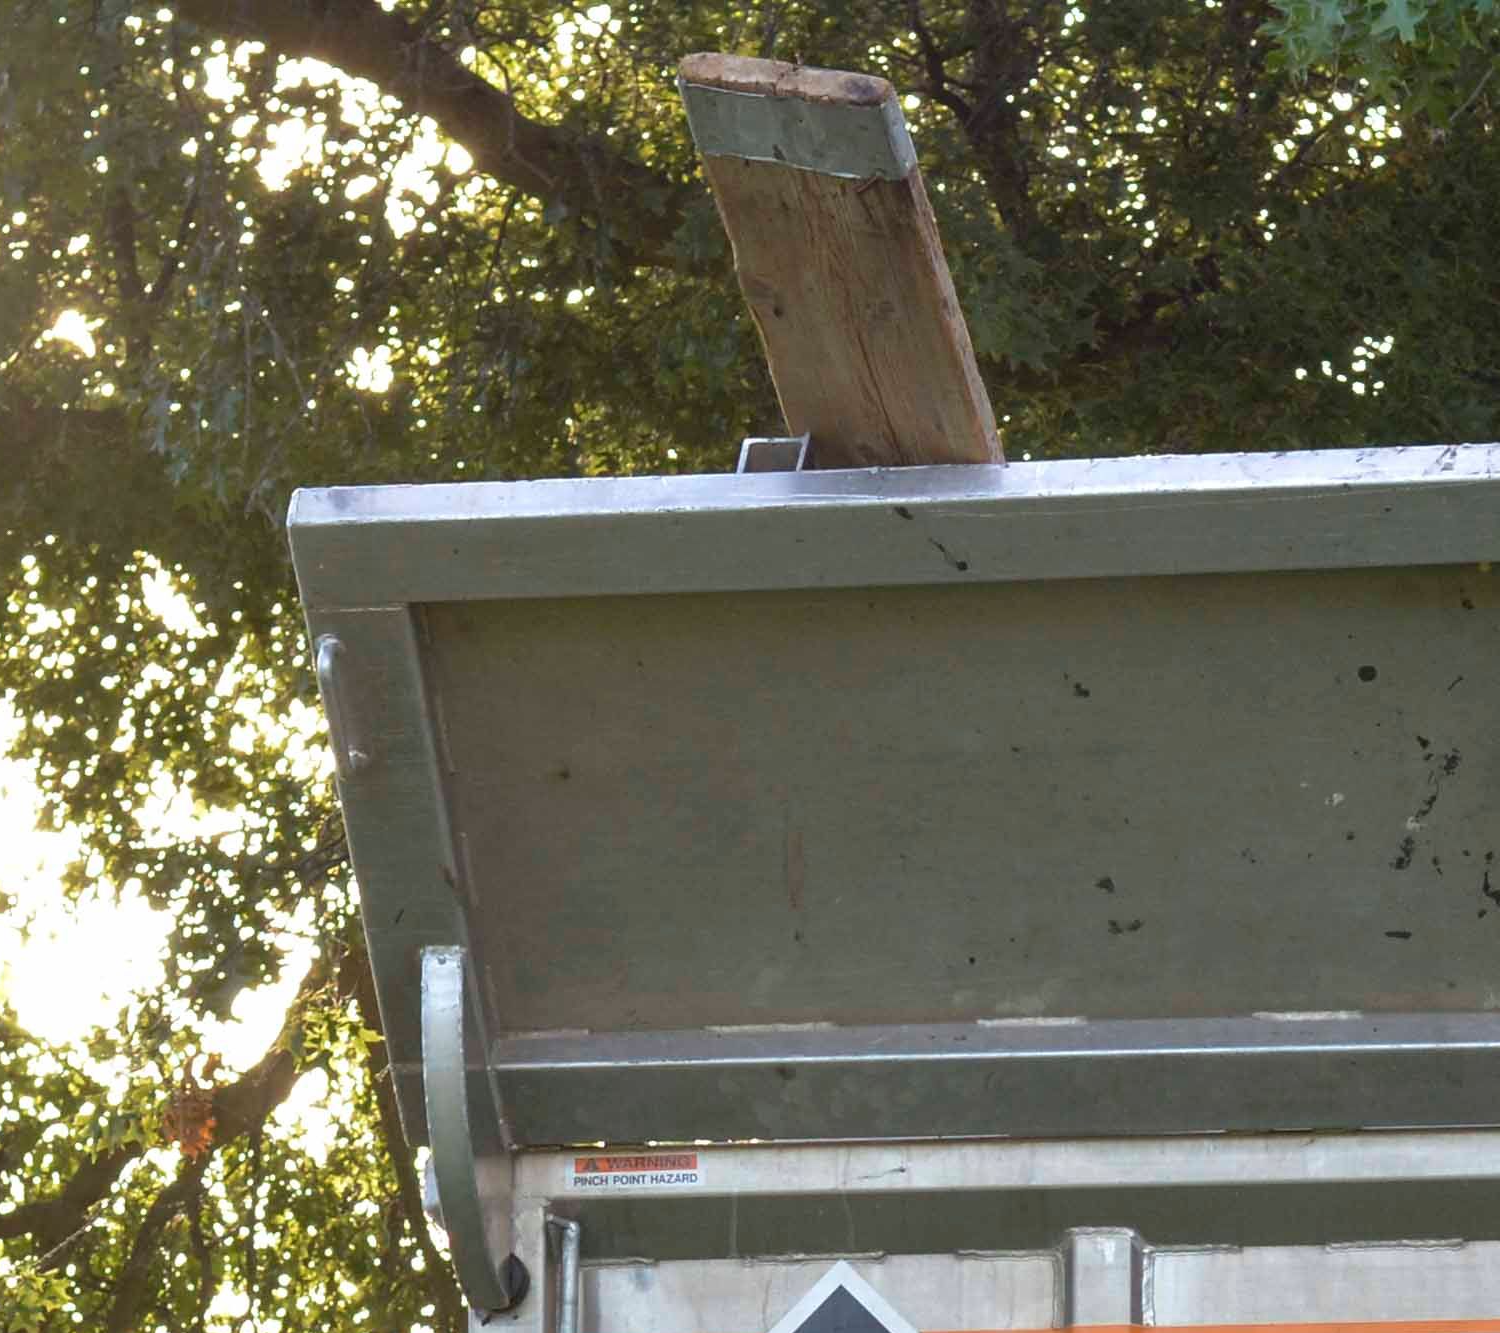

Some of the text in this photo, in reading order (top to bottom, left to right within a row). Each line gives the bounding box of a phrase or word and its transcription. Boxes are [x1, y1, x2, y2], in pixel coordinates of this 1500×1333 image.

[608, 1154, 692, 1169] WARNING
[573, 1173, 698, 1187] PINCH POINT HAZARD
